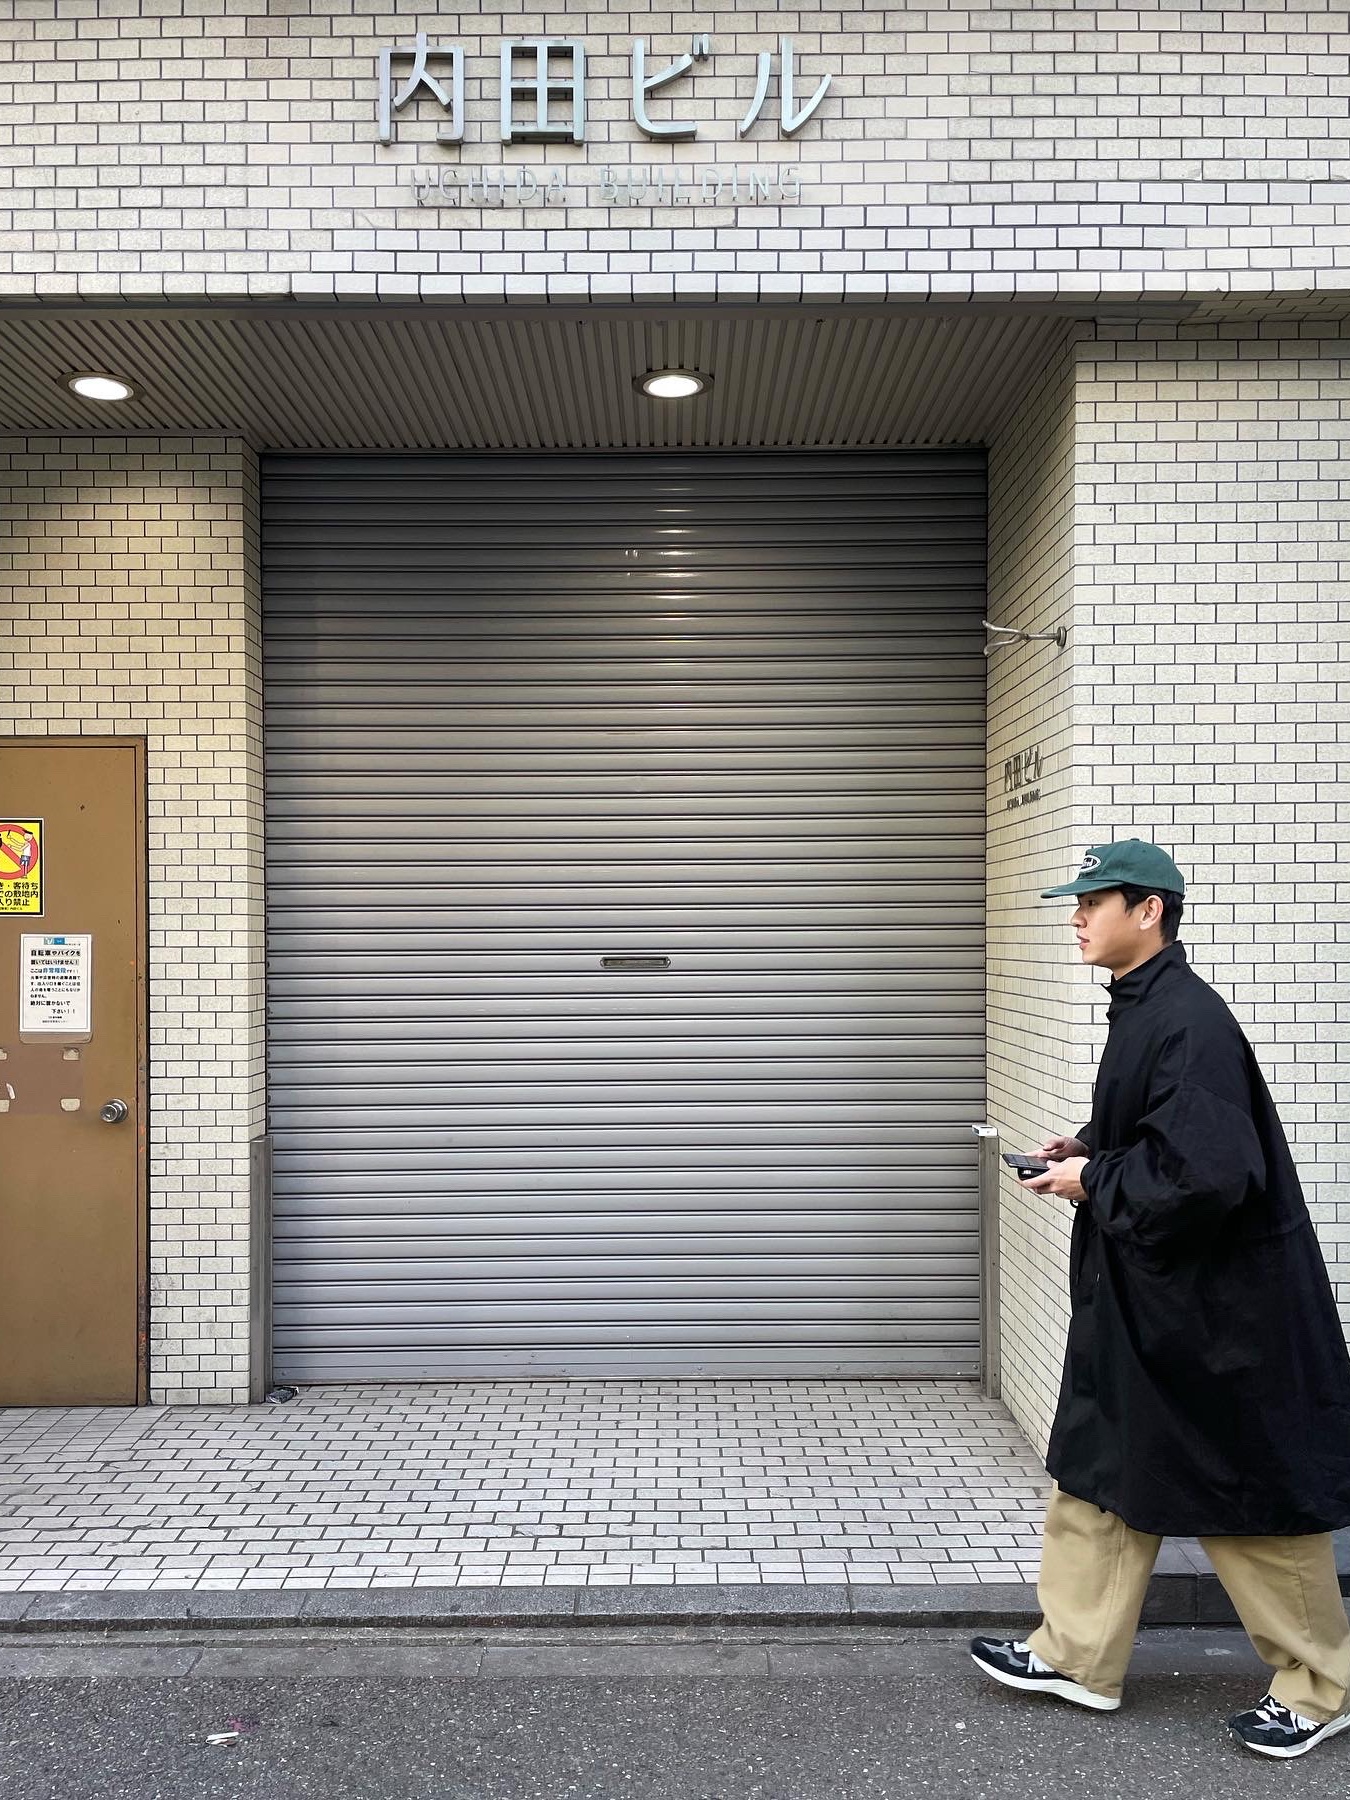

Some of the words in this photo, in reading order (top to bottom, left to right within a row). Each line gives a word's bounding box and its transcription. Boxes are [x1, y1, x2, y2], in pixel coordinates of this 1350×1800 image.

[379, 32, 832, 147] 内田ビル
[410, 168, 566, 201] UCHIDA
[599, 167, 801, 200] BUILDING
[30, 949, 81, 957] 自転車やバイクを
